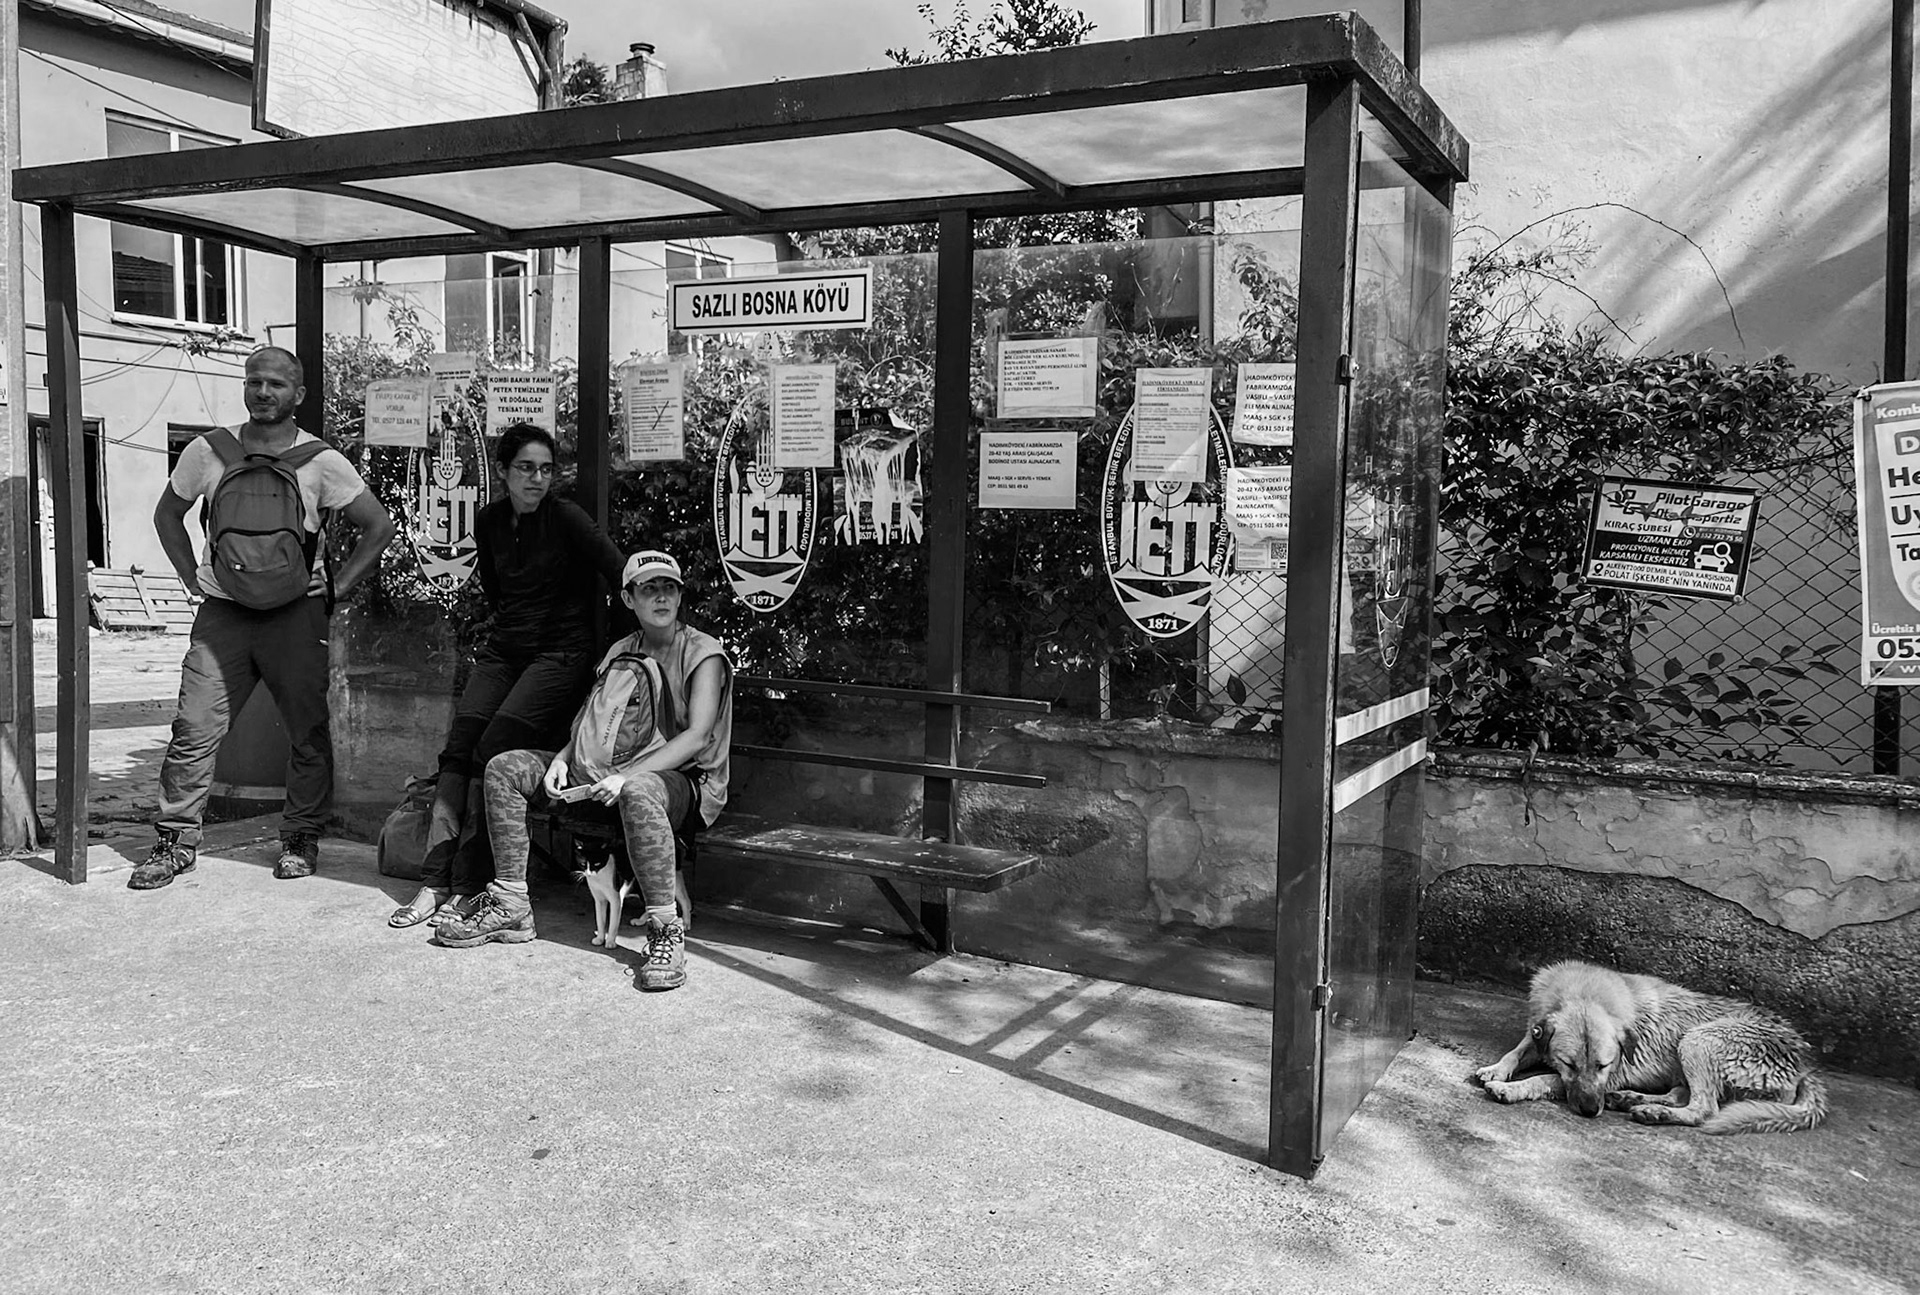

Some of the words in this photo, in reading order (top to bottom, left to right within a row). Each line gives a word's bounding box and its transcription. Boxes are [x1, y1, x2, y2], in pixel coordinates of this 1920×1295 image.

[692, 293, 736, 318] SAZLI
[742, 290, 798, 316] BOSNA
[803, 282, 849, 313] KÖYÜ
[524, 406, 544, 414] İŞLERİ
[804, 470, 812, 498] GENEL
[718, 511, 728, 548] İSTANBUL
[1604, 520, 1636, 532] KIRAÇ
[1637, 523, 1672, 532] ŞUBESİ
[1106, 520, 1118, 564] İSTANBUL
[1638, 536, 1670, 545] UZMAN
[1673, 538, 1692, 546] EKİP
[1662, 547, 1691, 556] HİZMET
[1600, 550, 1640, 560] KAPSAMLI
[1643, 553, 1689, 566] EKSPERTİZ
[1604, 570, 1630, 580] POLAT
[1632, 573, 1689, 586] İŞKEMBE'NİN
[1692, 580, 1731, 592] YANINDA
[1696, 572, 1734, 583] KARŞISINDA
[751, 596, 775, 606] 1871
[1148, 618, 1178, 630] 1871
[1872, 622, 1914, 634] Ücretsiz
